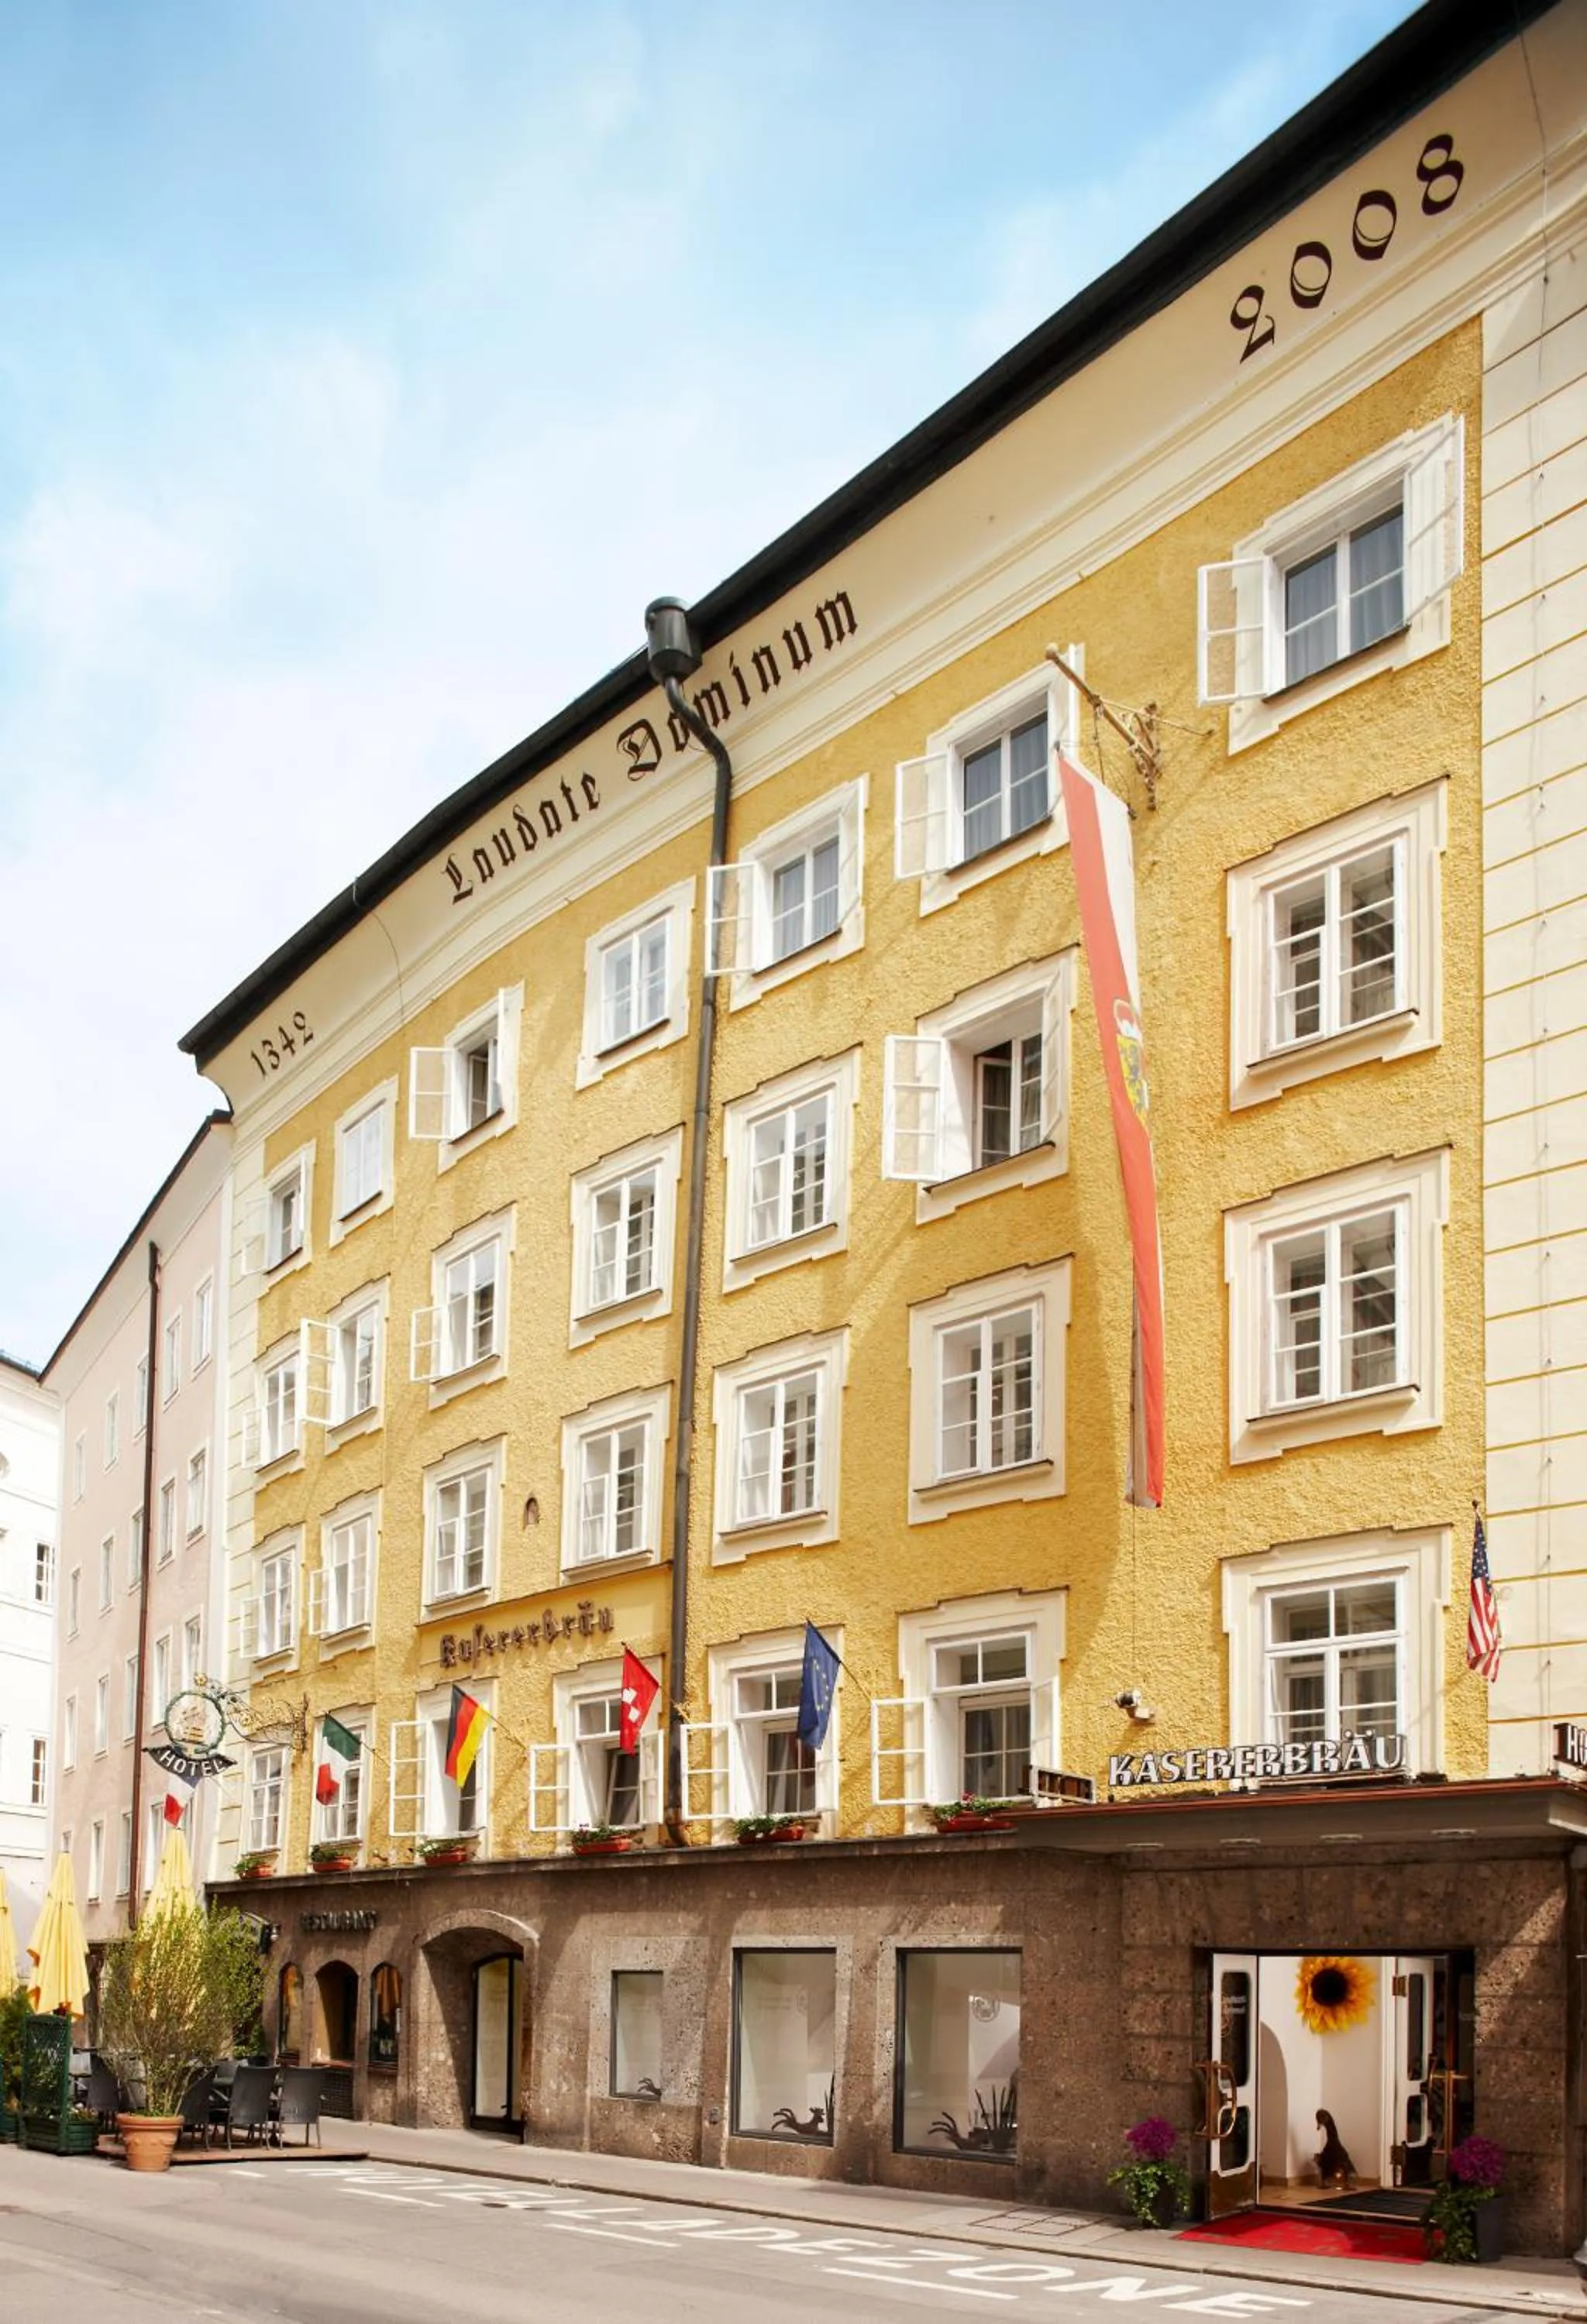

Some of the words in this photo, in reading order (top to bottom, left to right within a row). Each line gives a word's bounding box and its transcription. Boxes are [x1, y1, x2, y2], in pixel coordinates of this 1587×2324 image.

[1230, 133, 1465, 365] 2008
[442, 772, 601, 904] Laudate
[250, 1011, 314, 1078] 1342
[160, 1750, 225, 1776] HOTEL
[1108, 1728, 1406, 1786] KASERERBRÄU
